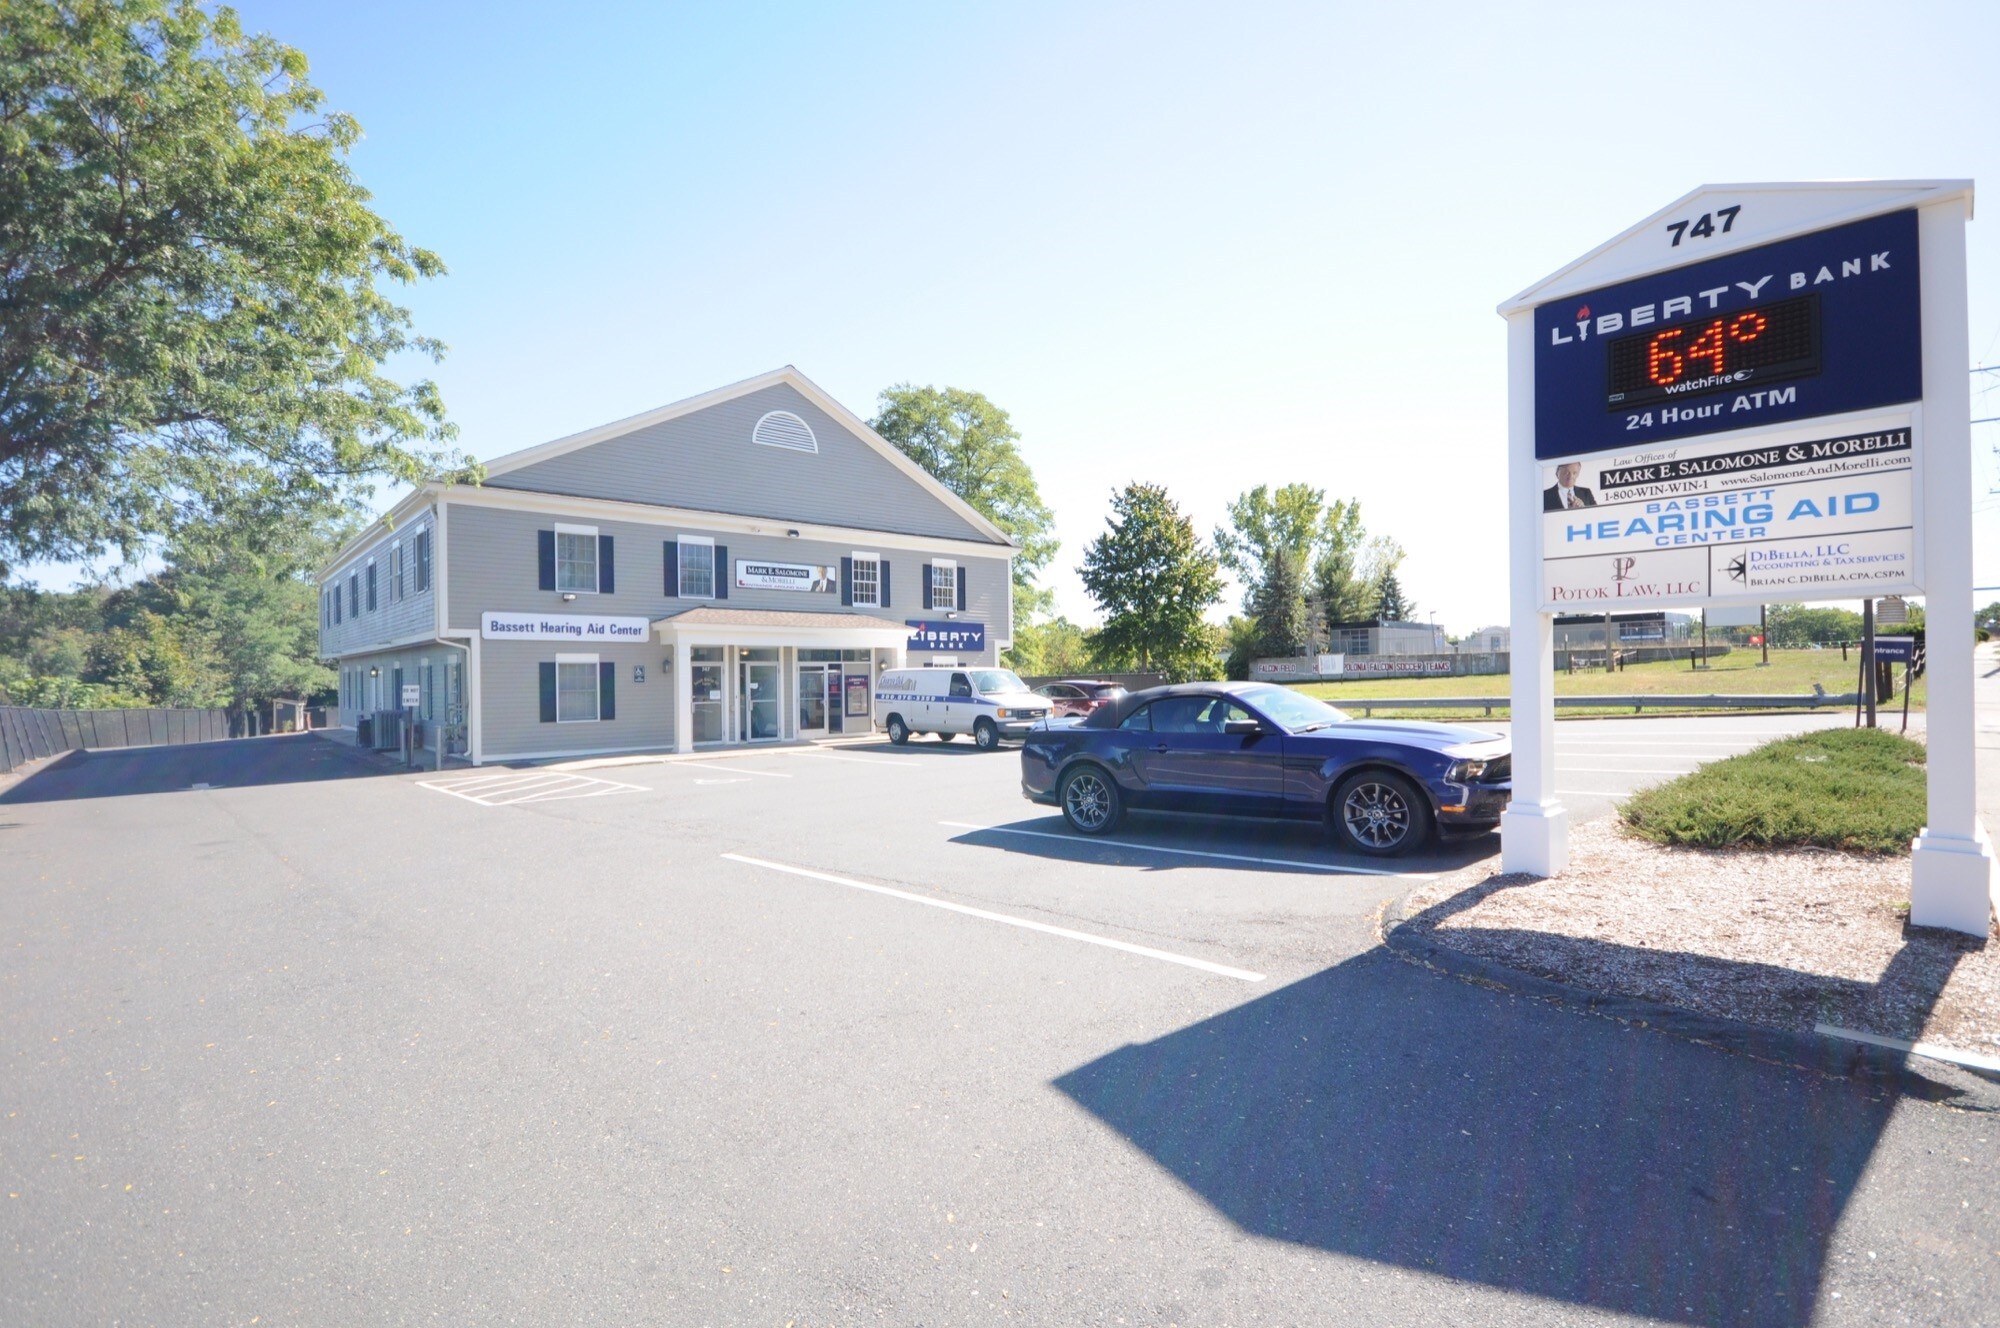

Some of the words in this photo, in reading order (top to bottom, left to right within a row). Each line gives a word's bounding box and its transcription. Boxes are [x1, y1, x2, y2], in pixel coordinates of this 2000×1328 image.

[1667, 205, 1741, 247] 747
[1552, 274, 1773, 346] LIBERTY
[1790, 251, 1891, 290] BANK
[1626, 412, 1653, 430] 24
[1662, 403, 1724, 424] Hour
[1731, 387, 1796, 412] ATM
[1604, 469, 1655, 485] MARK
[1659, 465, 1675, 478] E.
[1679, 451, 1779, 475] SALOMONE
[1786, 446, 1807, 462] &
[1811, 432, 1906, 458] MORELLI
[1613, 458, 1632, 467] Law
[1634, 453, 1665, 464] Offices
[1667, 449, 1678, 460] of
[1604, 480, 1708, 501] 1-800-WIN-WIN-1
[1720, 456, 1911, 486] www.SalomoneAndMorelli.com
[1646, 489, 1775, 514] BASSETT
[1566, 503, 1774, 542] HEARING
[1787, 491, 1880, 521] AID
[1655, 526, 1767, 547] CENTER
[1817, 543, 1849, 557] LLC
[747, 566, 767, 575] MARK
[775, 568, 808, 577] SALOMONE
[1750, 560, 1819, 571] ACCOUNTING
[1823, 558, 1831, 566] &
[1834, 556, 1854, 566] TAX
[1856, 553, 1905, 564] SERVICES
[1552, 586, 1609, 601] POTOK
[1616, 582, 1660, 598] LAW,
[1667, 581, 1701, 595] LLC
[1751, 577, 1785, 586] BRIAN
[490, 620, 535, 633] Bassett
[540, 621, 582, 636] Hearing
[587, 623, 605, 635] Aid
[609, 623, 643, 636] Center
[1368, 662, 1394, 671] FALCON
[1396, 661, 1423, 671] SOCCER
